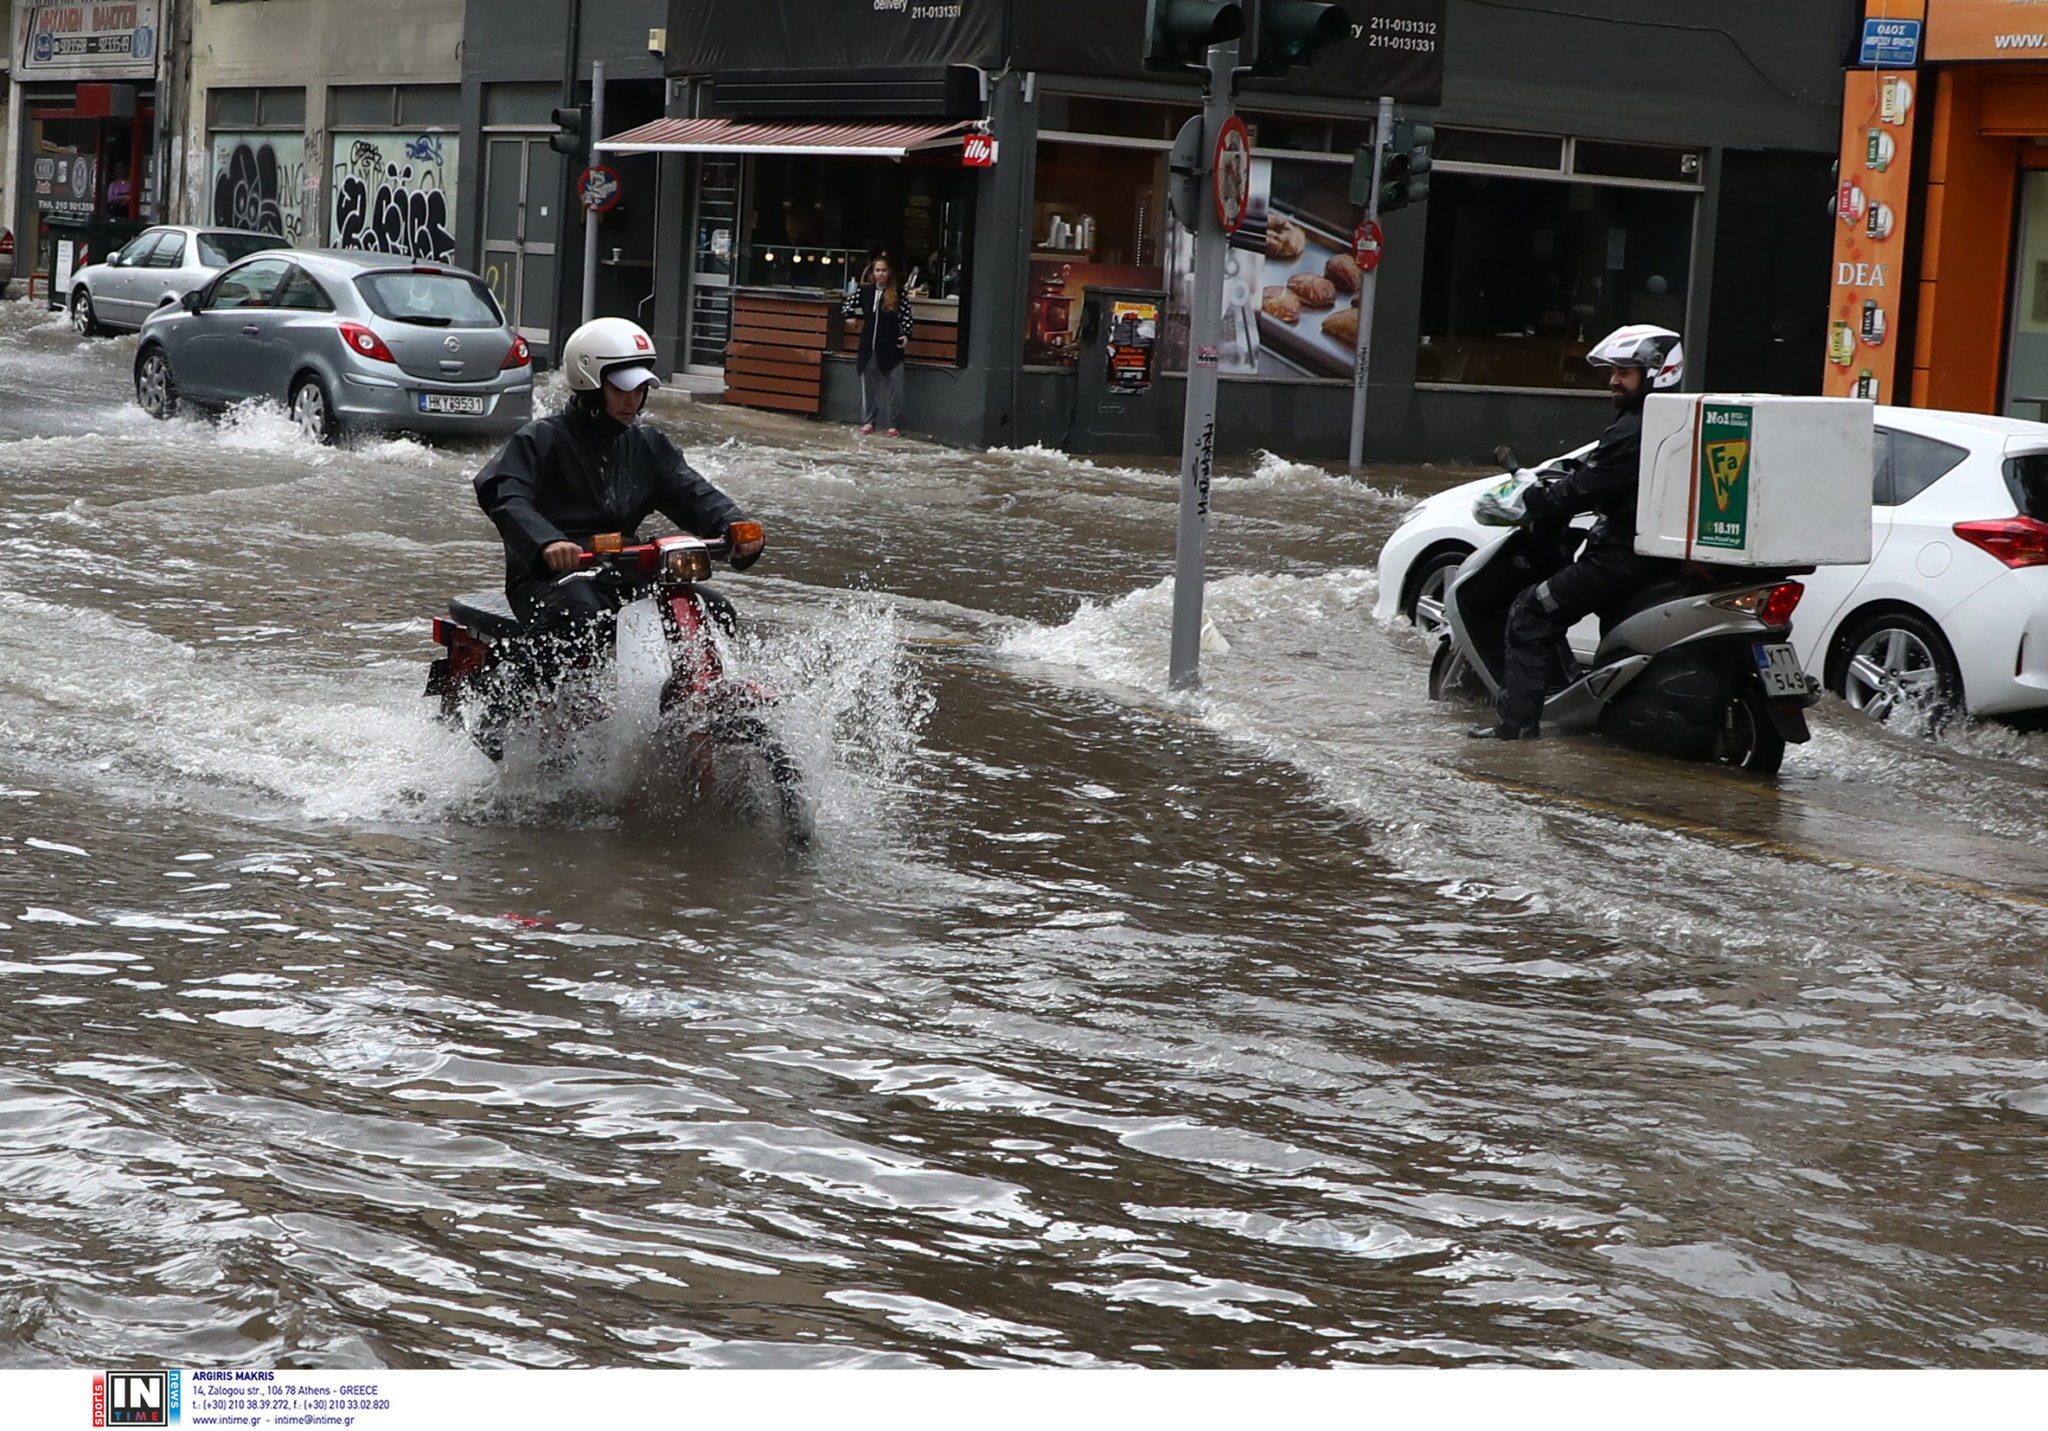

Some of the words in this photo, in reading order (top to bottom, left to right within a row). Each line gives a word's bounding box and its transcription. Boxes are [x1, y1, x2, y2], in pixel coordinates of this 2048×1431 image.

[912, 5, 961, 18] 211-0131331
[1371, 17, 1437, 34] 211-0131312
[1369, 35, 1434, 51] 211-0131331
[964, 139, 991, 164] illy
[1713, 521, 1741, 535] 18.111
[1773, 671, 1805, 690] 549
